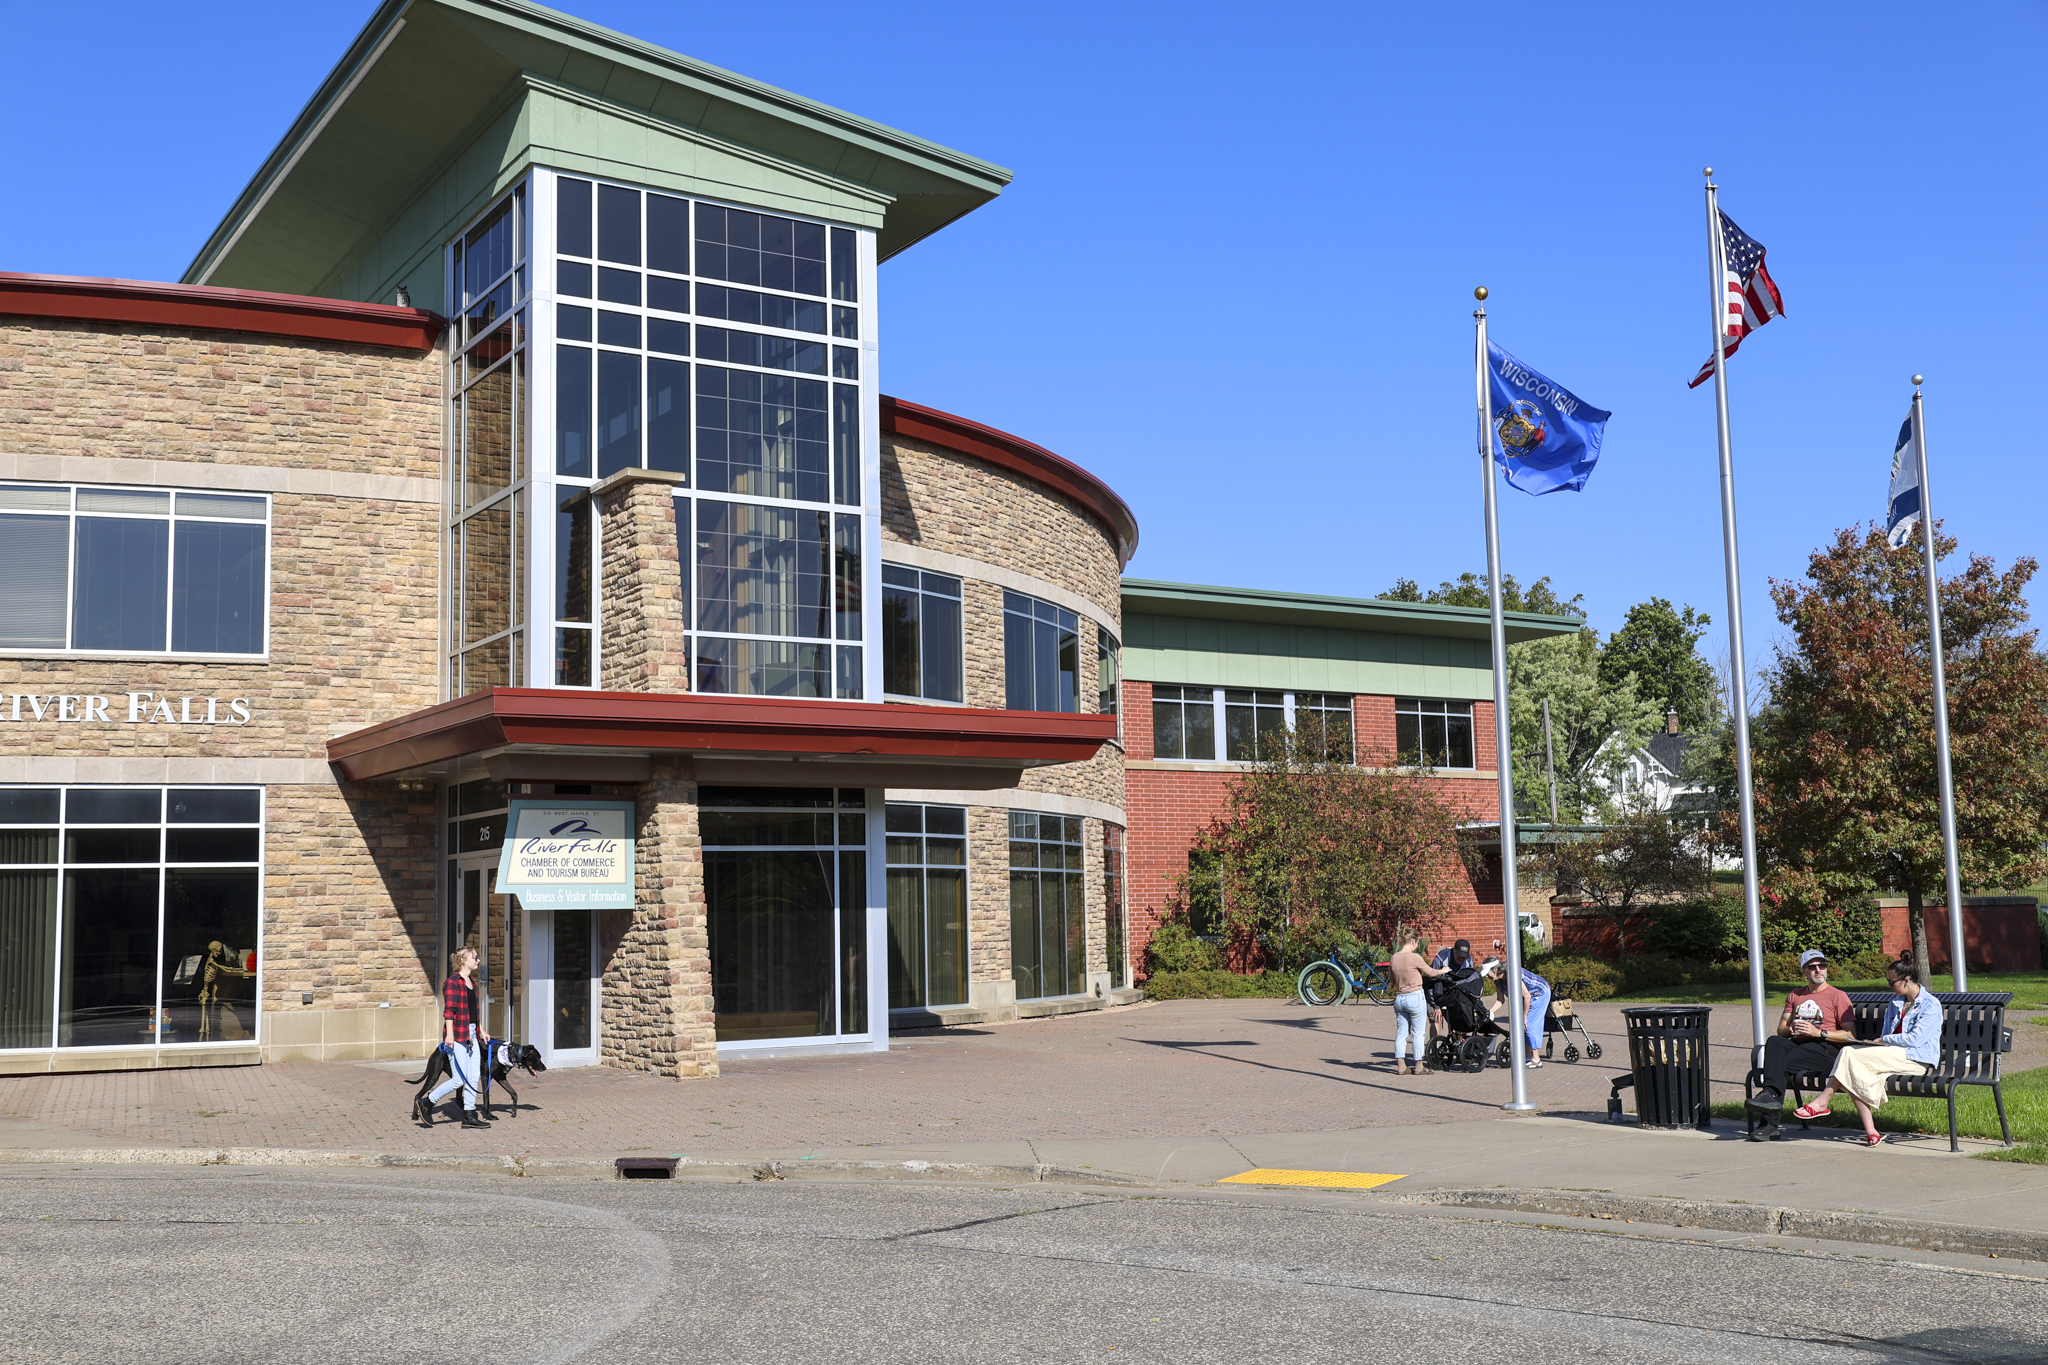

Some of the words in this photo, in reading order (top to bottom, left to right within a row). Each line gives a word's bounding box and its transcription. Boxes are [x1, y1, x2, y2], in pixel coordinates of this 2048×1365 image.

[1499, 359, 1579, 416] WISCONSIN
[0, 692, 112, 722] IVER
[124, 691, 250, 725] FALLS
[480, 826, 490, 841] 215
[520, 837, 568, 854] River
[568, 838, 617, 854] Falls
[521, 857, 559, 867] CHAMBER
[561, 857, 570, 867] OF
[573, 857, 615, 867] COMMERCE
[528, 868, 544, 878] AND
[546, 868, 578, 878] TOURISM
[581, 868, 609, 878] BUREAU
[526, 889, 556, 903] Business
[558, 889, 564, 902] &
[565, 889, 587, 902] Visitor
[589, 888, 627, 902] Information
